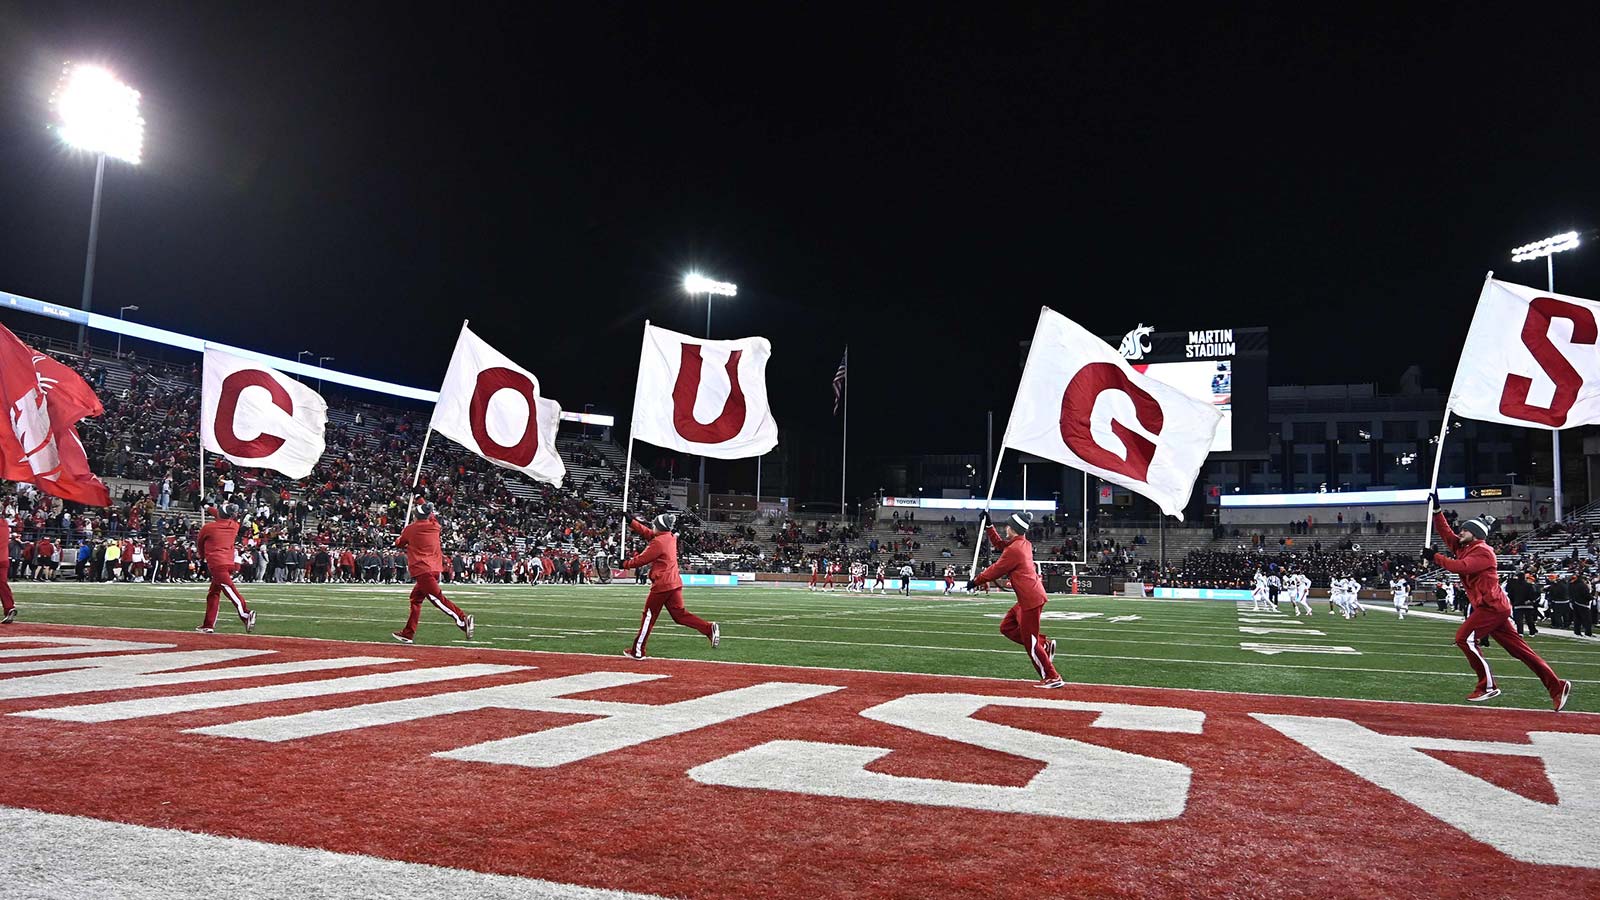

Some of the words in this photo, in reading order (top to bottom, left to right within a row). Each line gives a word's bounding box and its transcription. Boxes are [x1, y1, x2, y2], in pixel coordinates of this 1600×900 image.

[1185, 342, 1236, 358] STADIUM
[1188, 329, 1233, 345] MARTIN
[1499, 297, 1598, 428] S
[214, 369, 294, 459] C
[469, 366, 540, 468] O
[672, 343, 746, 444] U
[1060, 362, 1164, 483] G
